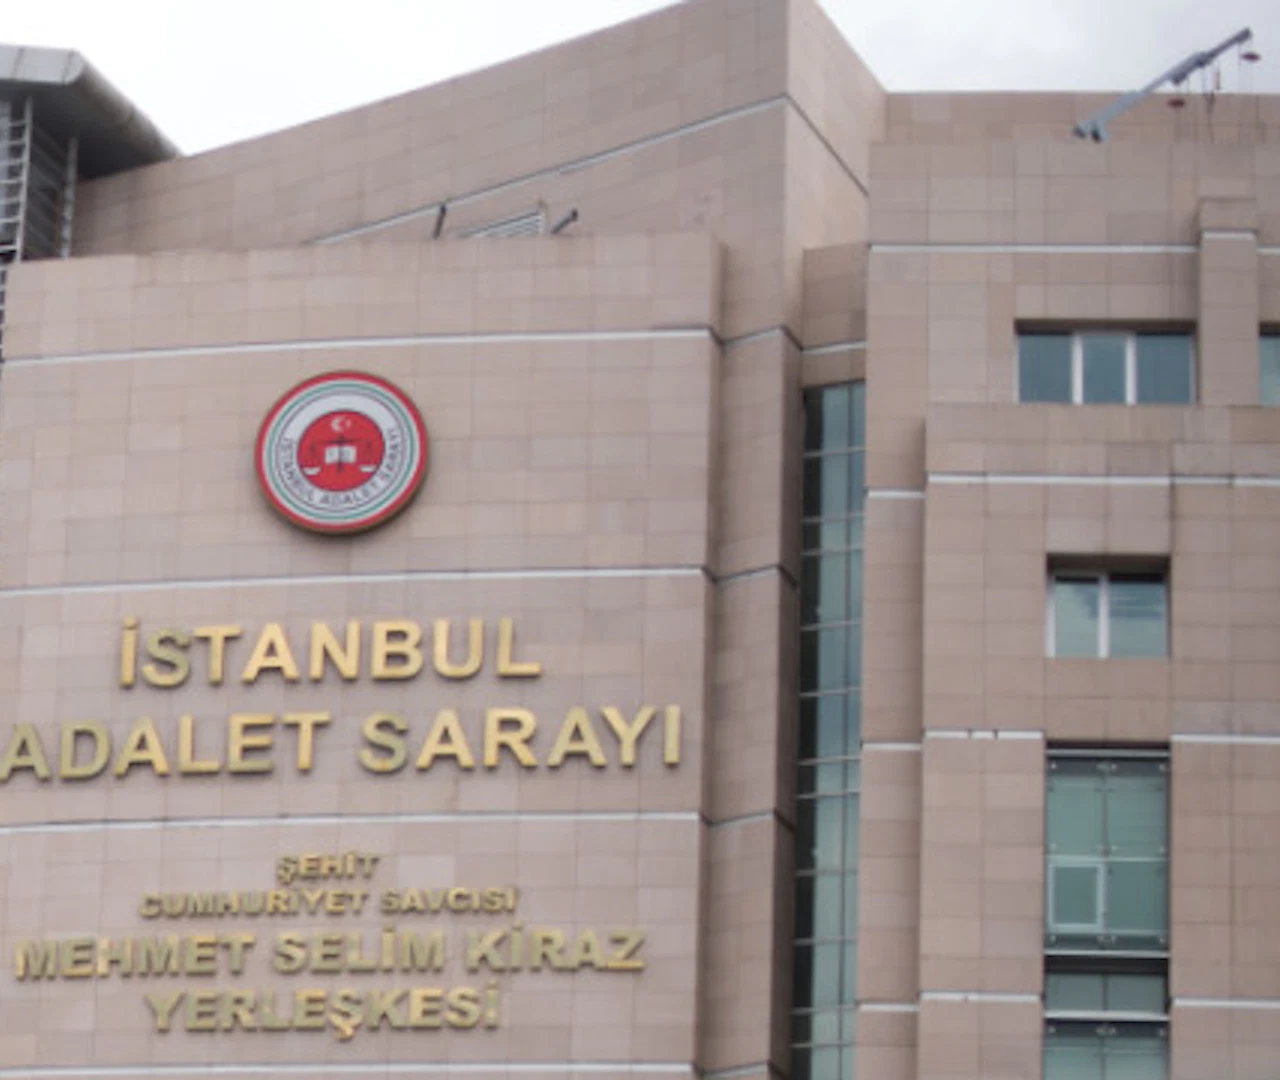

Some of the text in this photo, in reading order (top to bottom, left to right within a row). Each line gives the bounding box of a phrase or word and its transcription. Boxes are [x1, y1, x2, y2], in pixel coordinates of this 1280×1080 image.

[119, 616, 543, 690] İSTANBUL
[358, 704, 683, 774] SARAYI
[276, 851, 382, 886] ŞEHİT
[137, 886, 518, 920] CUMHURİYET SAVCISI
[14, 922, 647, 980] MEHMET SELİM KİRAZ
[143, 984, 501, 1040] YERLEŞKESİ
